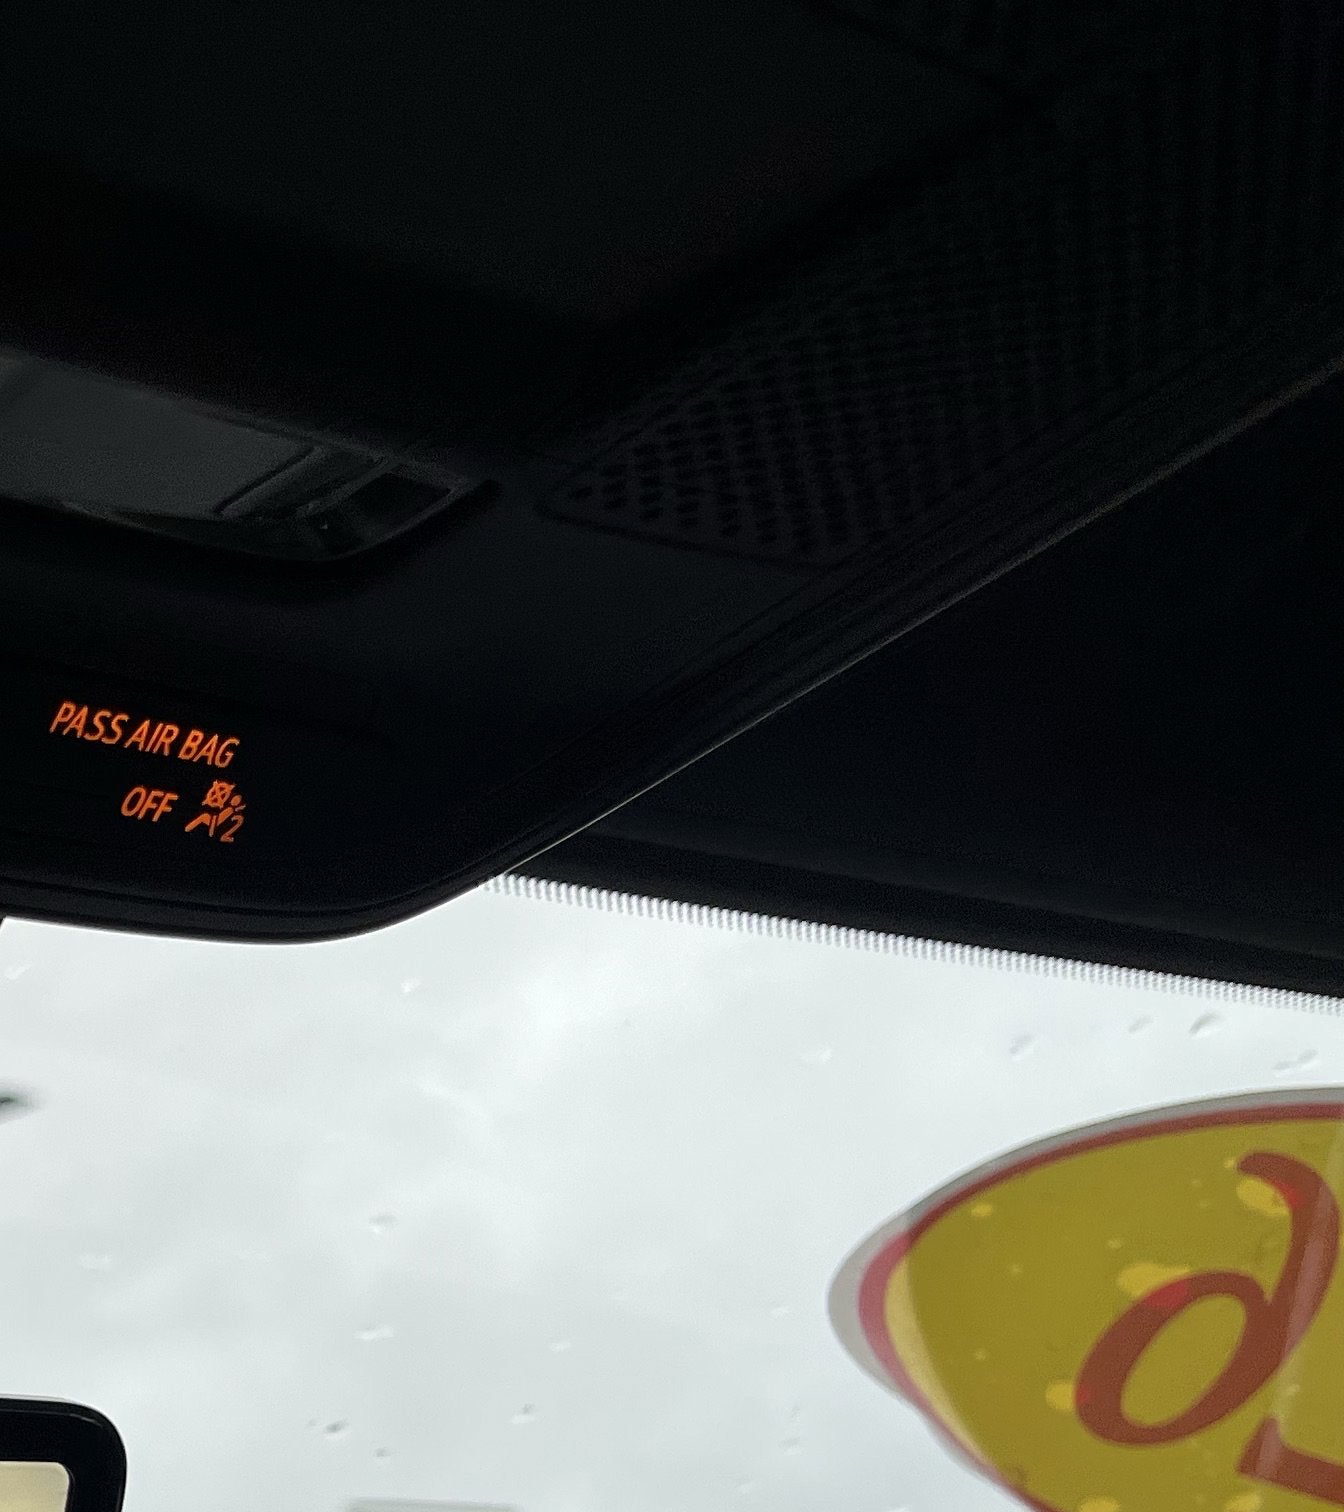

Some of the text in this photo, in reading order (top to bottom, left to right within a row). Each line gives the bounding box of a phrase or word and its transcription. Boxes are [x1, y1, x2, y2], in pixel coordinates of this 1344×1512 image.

[49, 701, 241, 768] PASS AIR BAG
[120, 785, 179, 822] OFF
